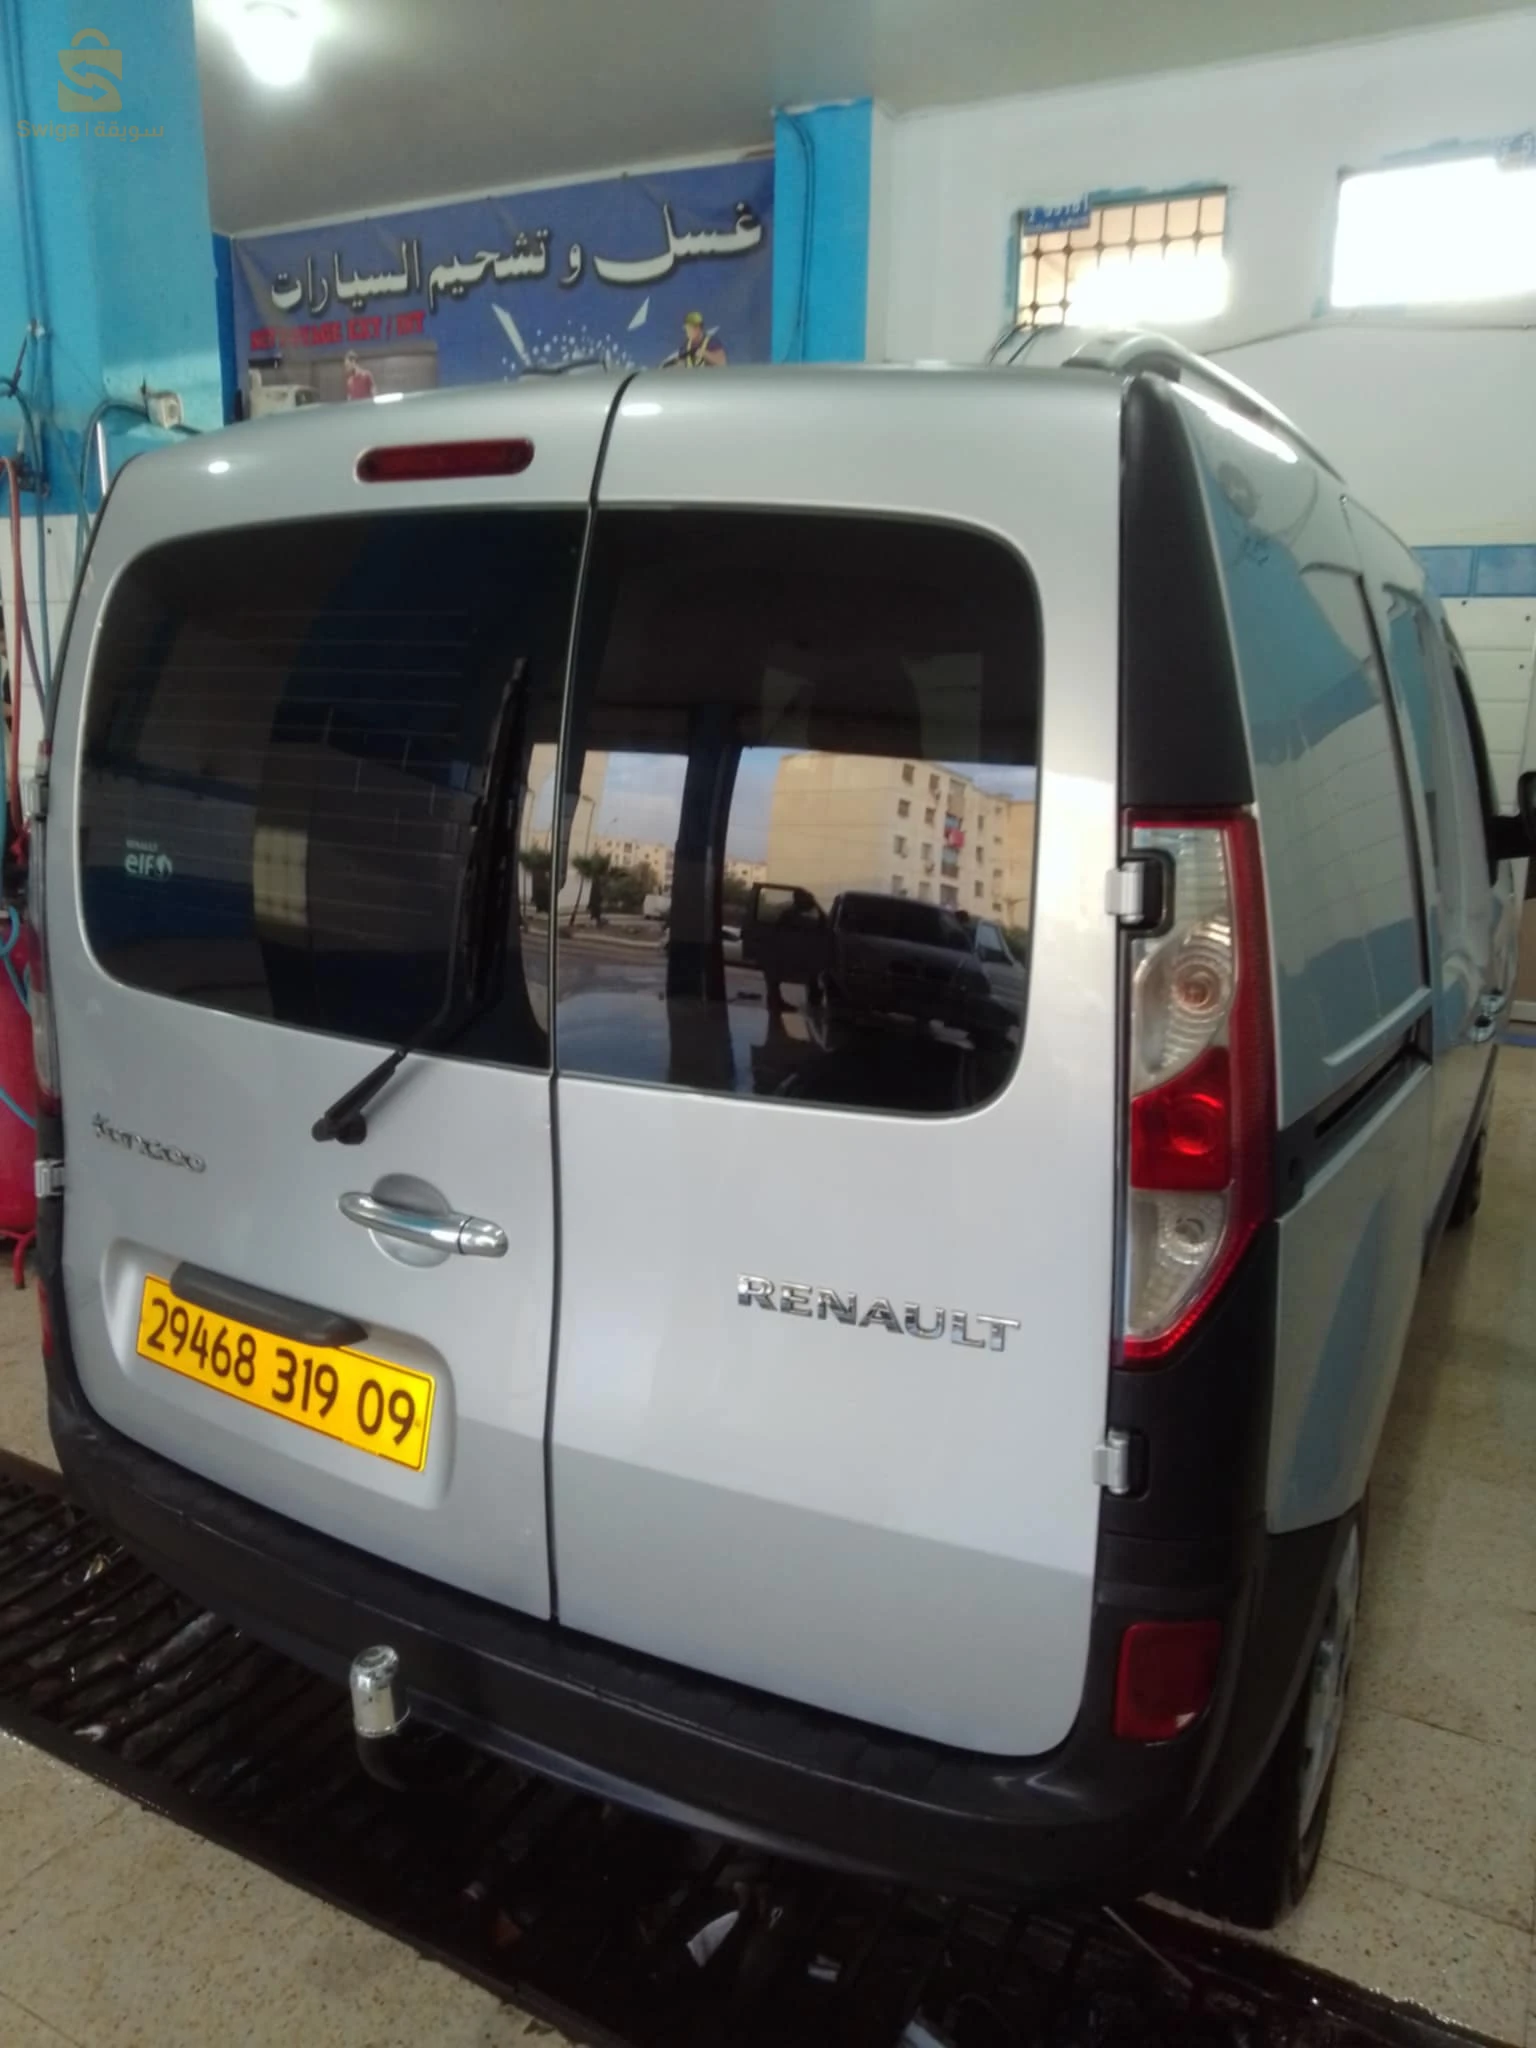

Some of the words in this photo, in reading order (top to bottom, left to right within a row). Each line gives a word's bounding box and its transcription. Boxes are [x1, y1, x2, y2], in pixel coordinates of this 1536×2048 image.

[271, 239, 420, 313] السيارات
[429, 228, 549, 309] تشحيم
[560, 242, 582, 285] و
[593, 202, 762, 283] غسل
[736, 1272, 1021, 1352] RENAULT
[146, 1297, 257, 1387] 29468
[271, 1346, 340, 1419] 319
[356, 1378, 416, 1446] 09
